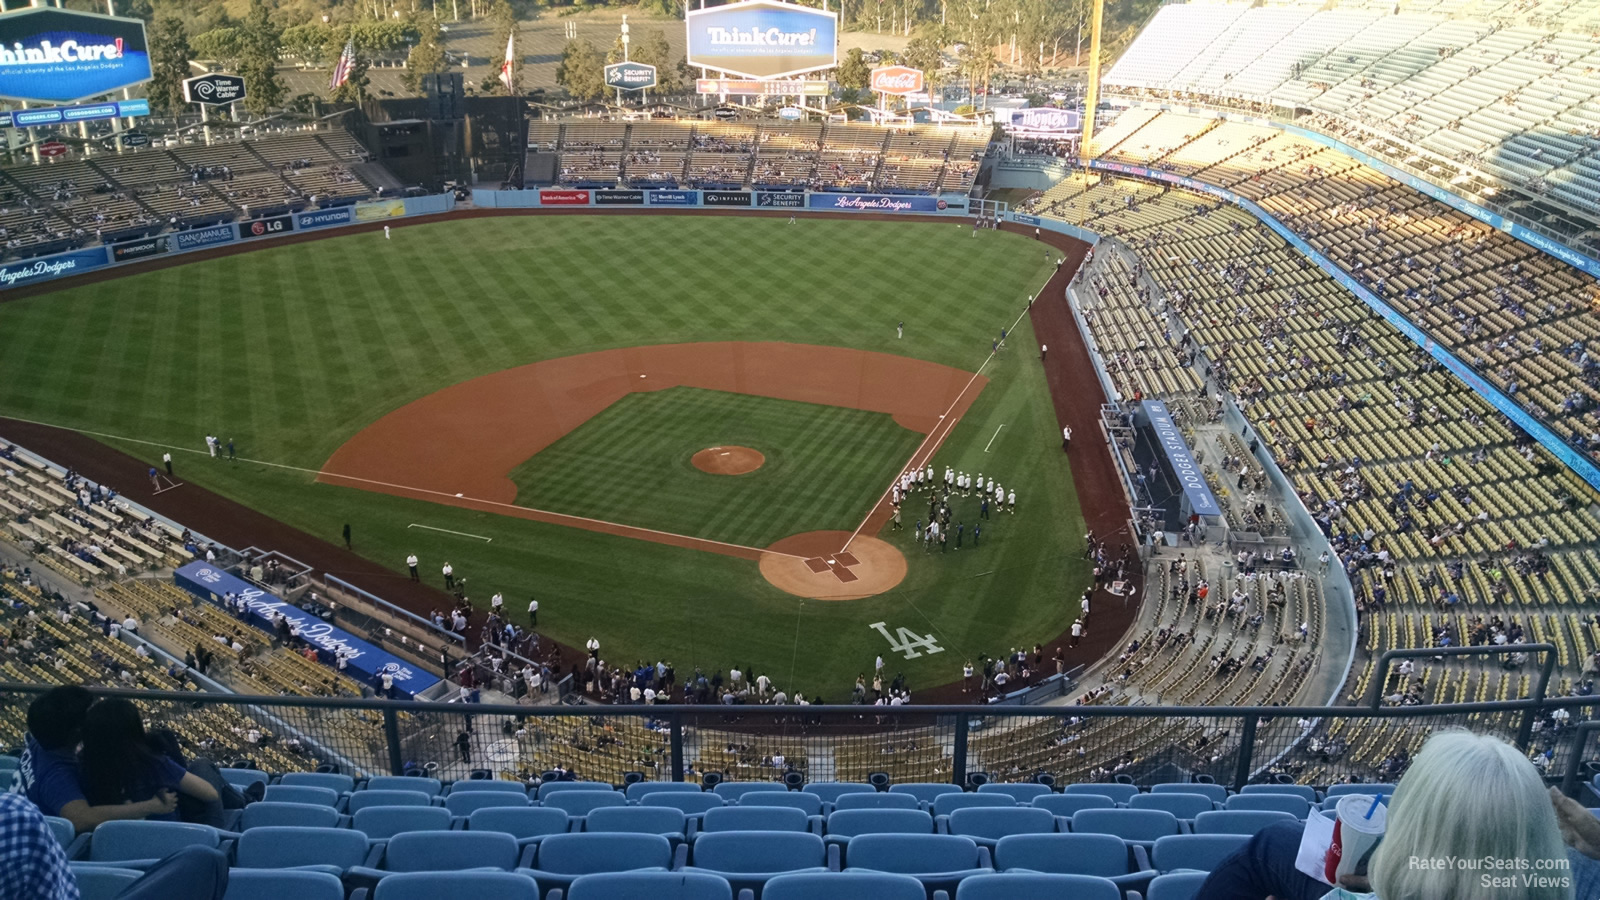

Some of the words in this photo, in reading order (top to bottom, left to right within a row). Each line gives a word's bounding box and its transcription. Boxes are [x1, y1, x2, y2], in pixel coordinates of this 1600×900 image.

[707, 26, 817, 46] ThinkCure!
[0, 37, 124, 65] hinkCure!
[20, 112, 59, 121] DODGERS.COM
[834, 196, 849, 208] Los
[848, 196, 880, 210] Angeles
[879, 197, 912, 211] Dodgers
[314, 211, 349, 222] HYUNDAI
[267, 220, 283, 232] LG
[179, 232, 195, 243] SAN
[200, 227, 232, 240] MANUEL
[33, 260, 76, 275] Dodgers
[1155, 417, 1183, 450] STADIUM
[1173, 453, 1202, 489] DODGER
[868, 621, 945, 660] LA
